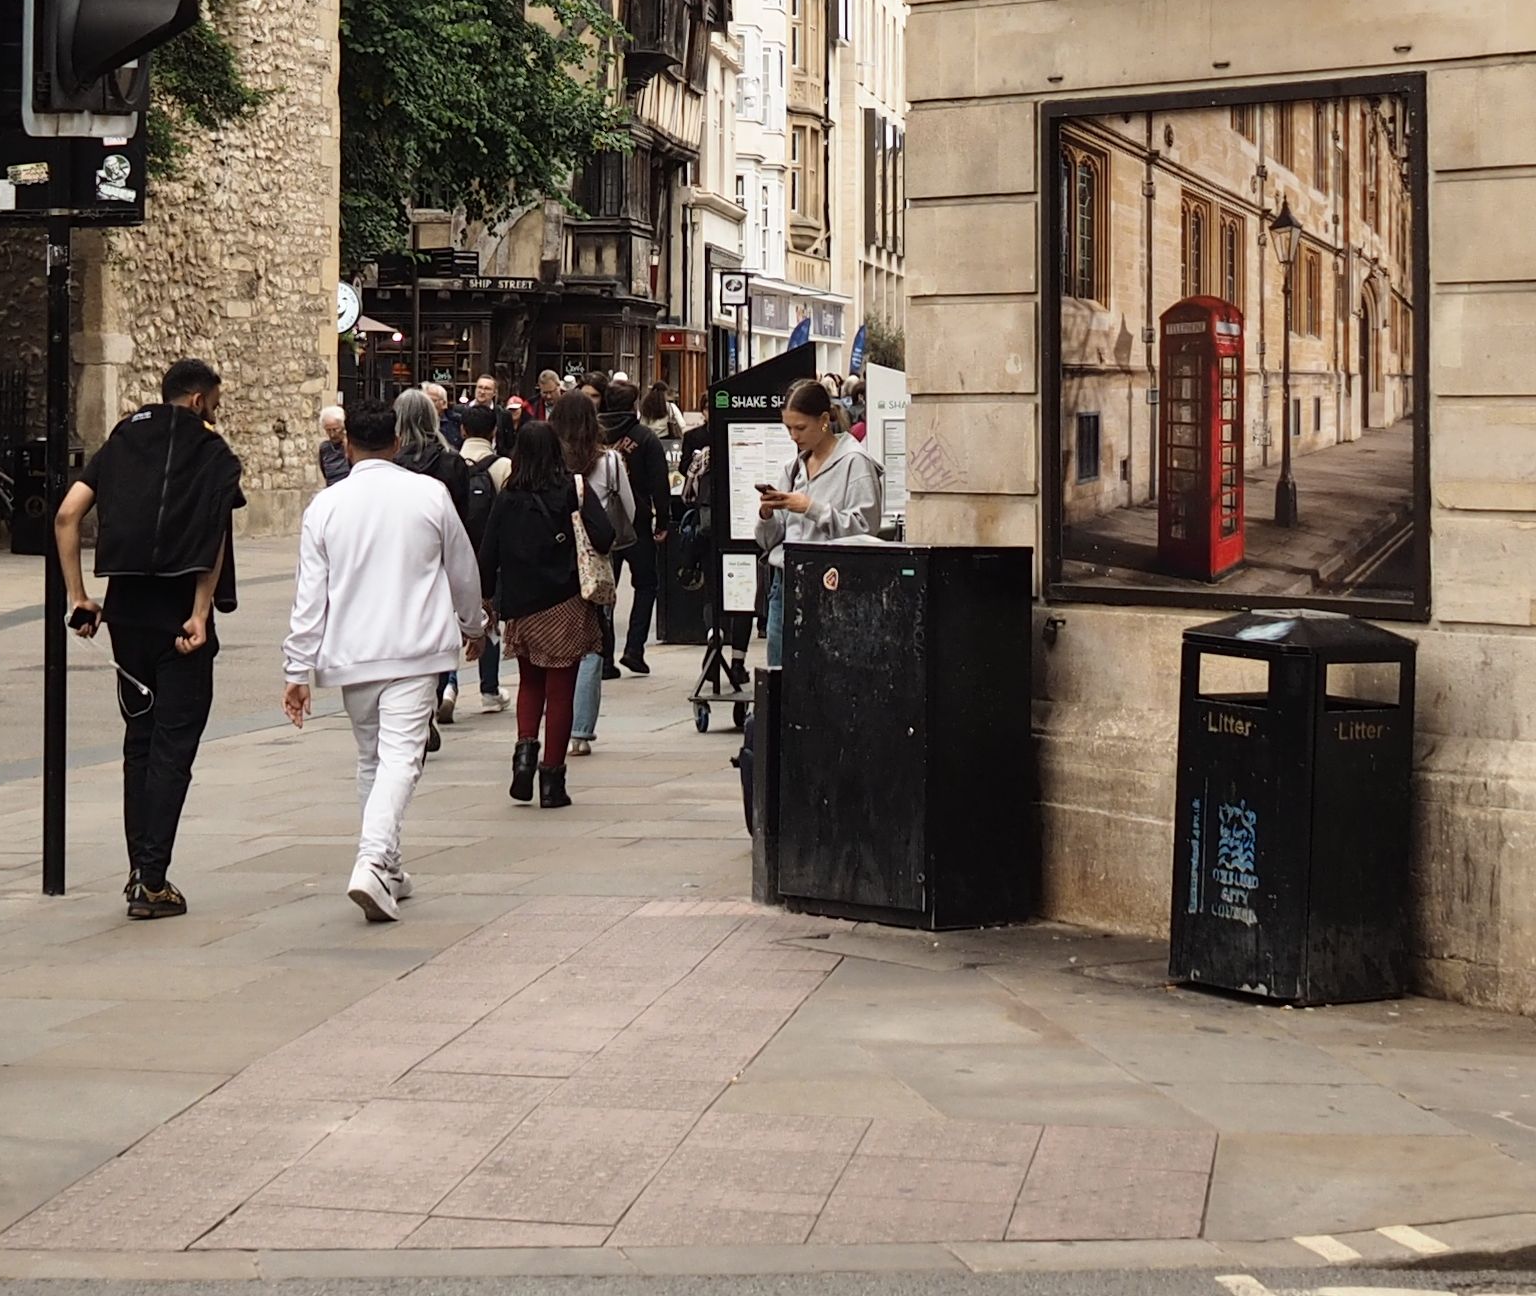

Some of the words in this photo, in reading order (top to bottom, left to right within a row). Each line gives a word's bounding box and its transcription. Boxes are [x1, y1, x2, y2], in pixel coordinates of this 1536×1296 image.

[469, 279, 492, 289] SHIP
[497, 280, 535, 290] STREET
[731, 395, 767, 408] SHAKE
[1208, 712, 1252, 736] Litter
[1338, 721, 1383, 740] Litter
